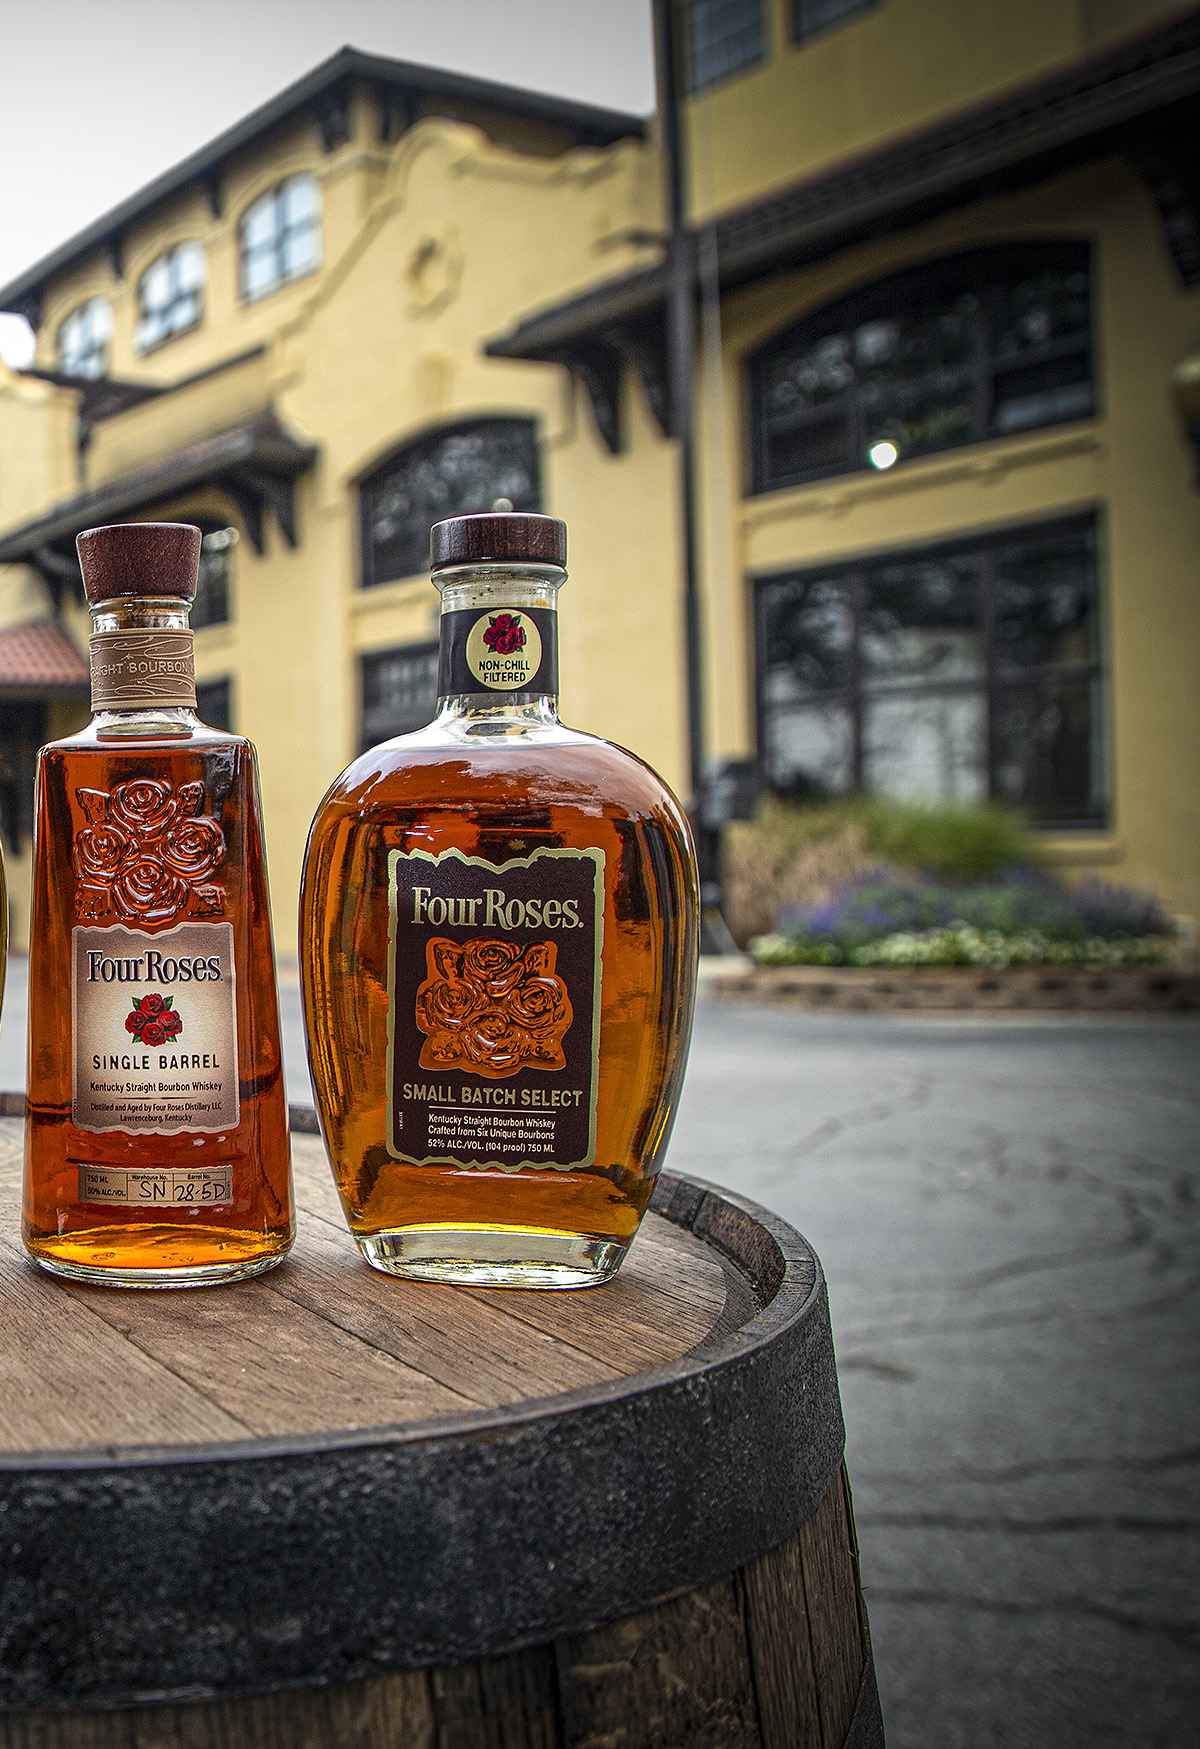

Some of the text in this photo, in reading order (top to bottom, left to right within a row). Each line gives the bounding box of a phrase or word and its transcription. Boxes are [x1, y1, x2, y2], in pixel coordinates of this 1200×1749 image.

[479, 660, 530, 671] NON-CHILL
[484, 672, 526, 682] FILTERED
[411, 886, 482, 927] Four
[87, 950, 144, 982] Four
[93, 1054, 220, 1070] SINGLE BARREL
[90, 1082, 222, 1094] Kentucky Straight Bourbon Whiskey
[403, 1083, 583, 1107] SMALL BATCH SELECT
[91, 1103, 114, 1111] Distilled
[115, 1103, 126, 1111] and
[127, 1104, 143, 1113] Aged
[144, 1104, 152, 1113] by
[185, 1103, 211, 1112] Distillery
[212, 1102, 222, 1110] LLC
[120, 1114, 192, 1123] Lawrenceburg, Kentucky
[428, 1114, 556, 1130] Kentucky Straight Bourbon Whiskey
[428, 1125, 555, 1140] Crafted from Six Unique Bourbons
[428, 1138, 445, 1148] 52%
[486, 1141, 502, 1151] (104
[503, 1142, 526, 1153] proof)
[528, 1143, 542, 1152] 750
[544, 1144, 555, 1153] ML
[139, 1181, 166, 1200] SN
